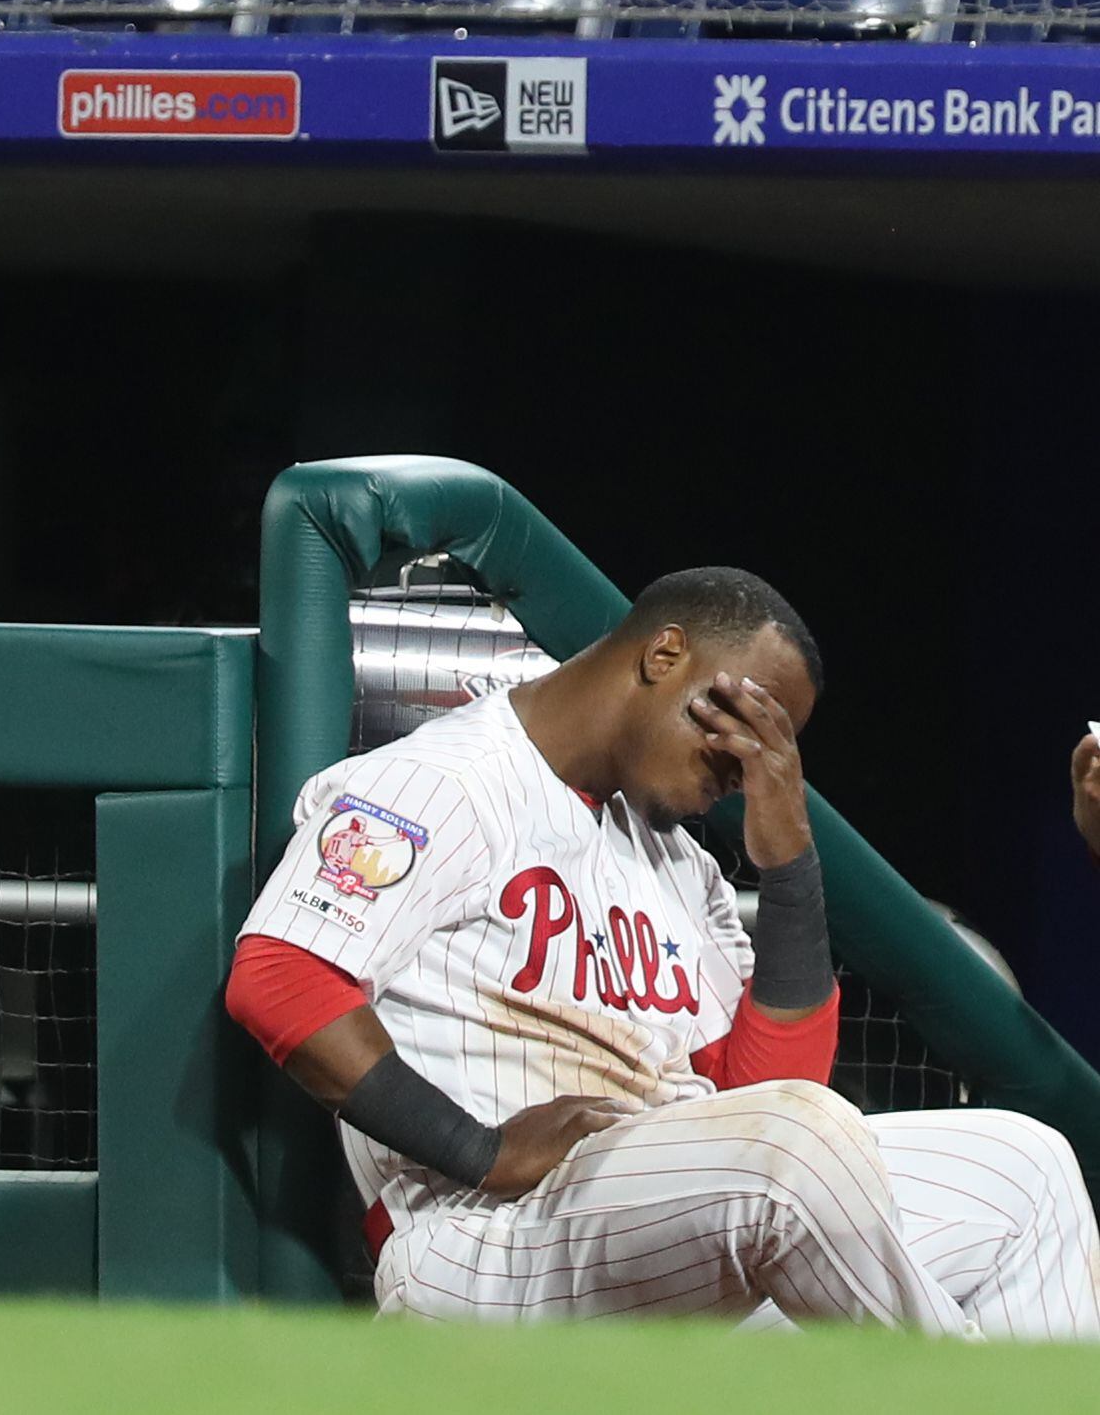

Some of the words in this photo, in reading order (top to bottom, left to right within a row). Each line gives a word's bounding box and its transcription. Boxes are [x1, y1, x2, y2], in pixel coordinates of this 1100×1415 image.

[70, 84, 288, 128] phillies.com
[519, 81, 574, 107] NEW
[779, 88, 936, 135] Citizens
[943, 87, 1041, 135] Bank
[519, 112, 573, 135] ERA
[379, 809, 425, 837] ROLLINS
[290, 889, 321, 908] MLB
[341, 912, 366, 933] 150
[499, 865, 700, 1017] Philli
